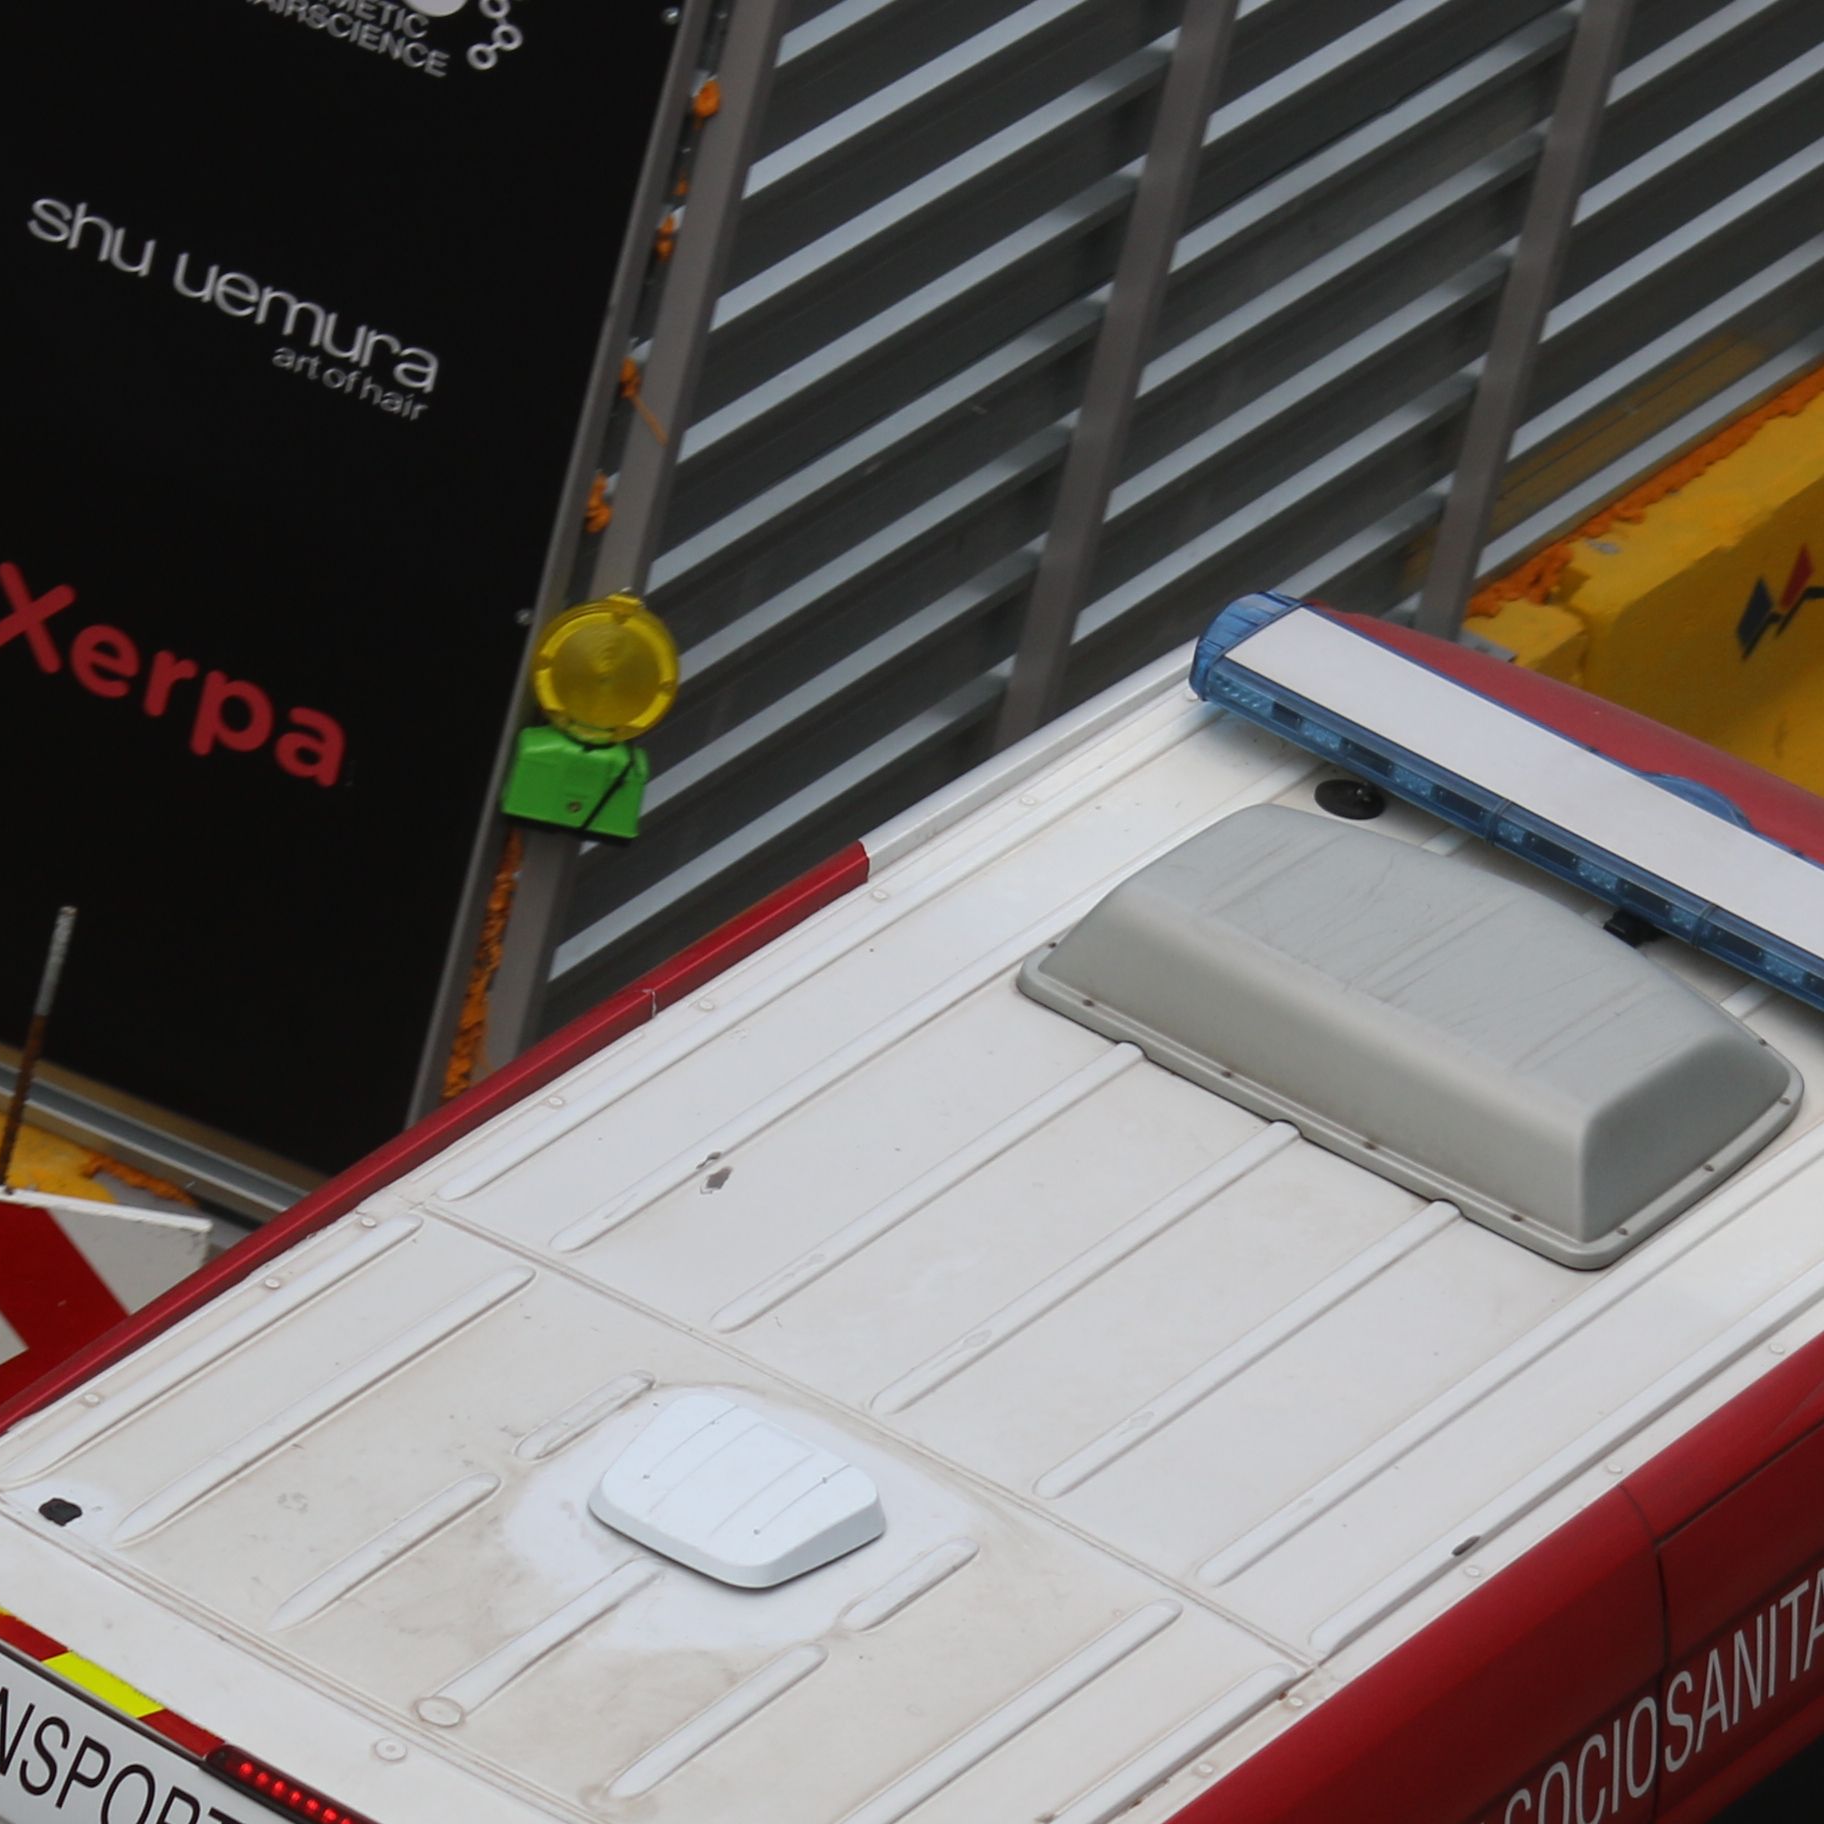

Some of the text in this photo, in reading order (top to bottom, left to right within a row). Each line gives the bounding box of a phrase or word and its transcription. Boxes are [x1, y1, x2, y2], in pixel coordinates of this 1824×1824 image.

[27, 198, 440, 394] shu uemura
[272, 347, 429, 421] art of hair
